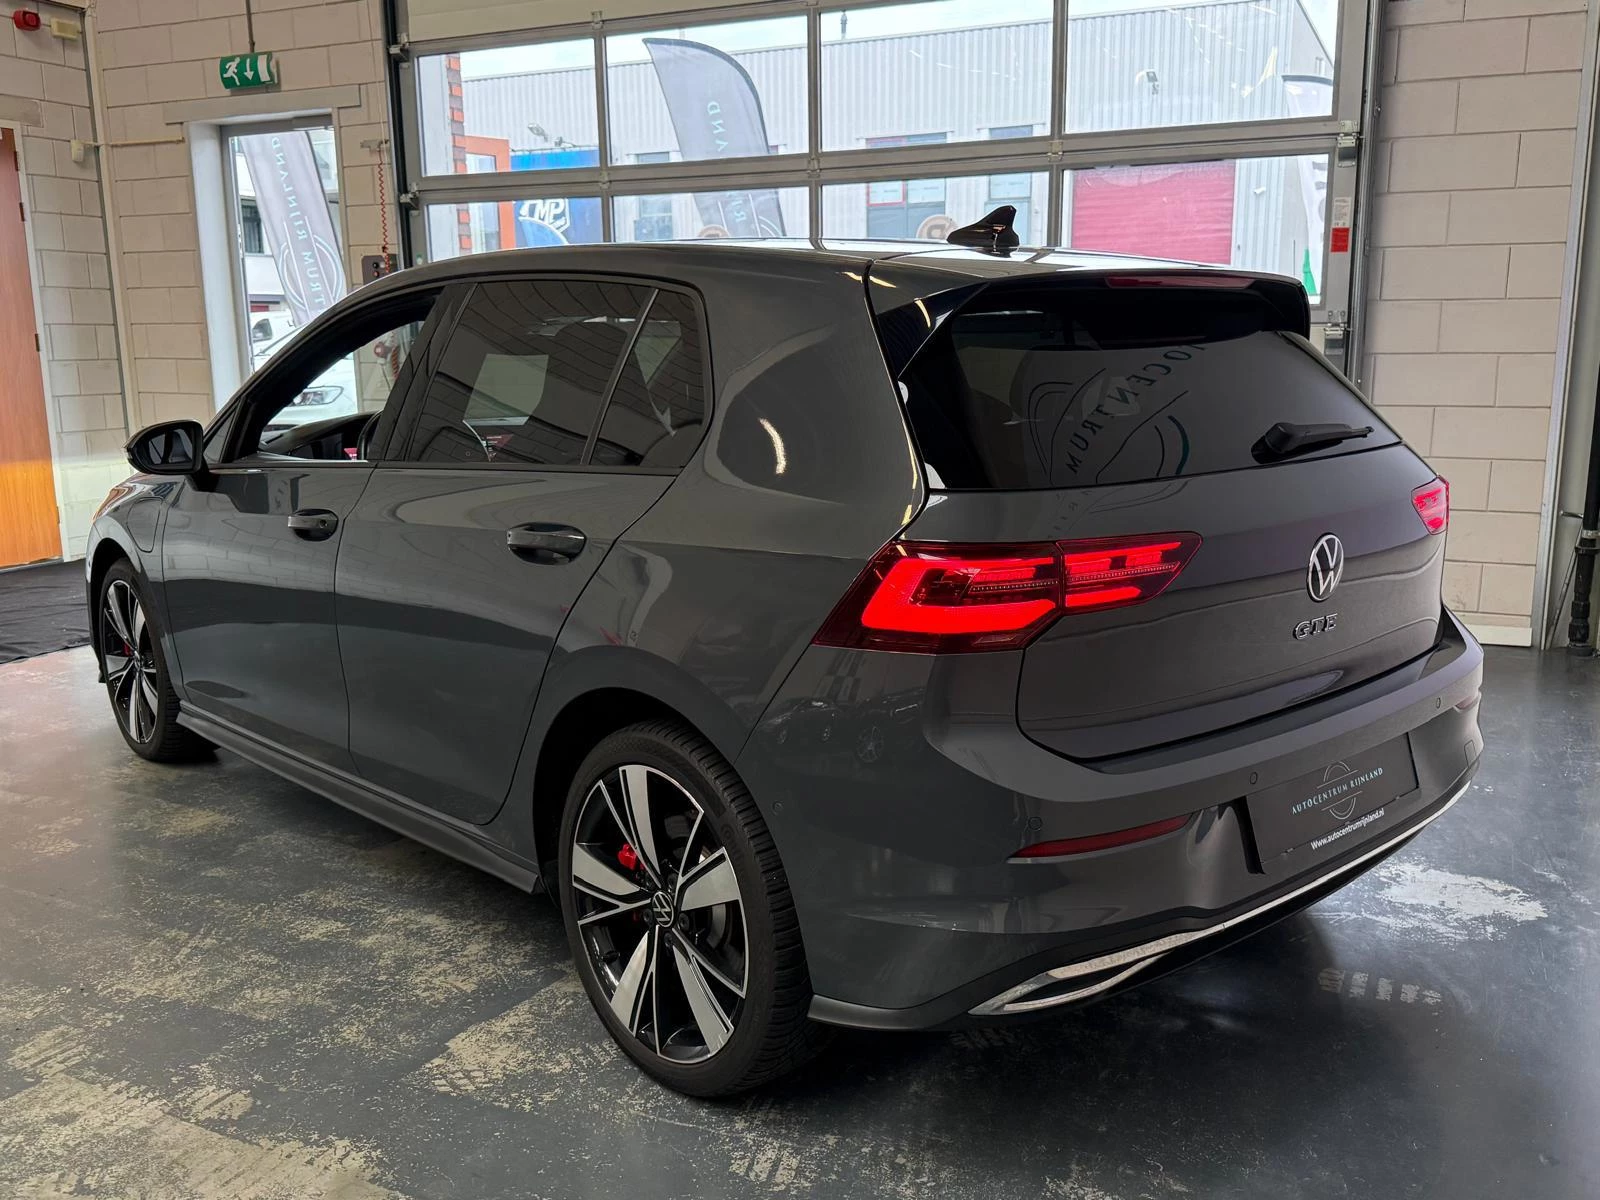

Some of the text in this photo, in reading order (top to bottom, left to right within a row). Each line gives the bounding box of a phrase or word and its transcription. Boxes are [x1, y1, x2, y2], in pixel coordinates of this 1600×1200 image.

[1293, 613, 1338, 640] GTE
[1292, 767, 1383, 815] AUTOCENTRUM RIJNLAND
